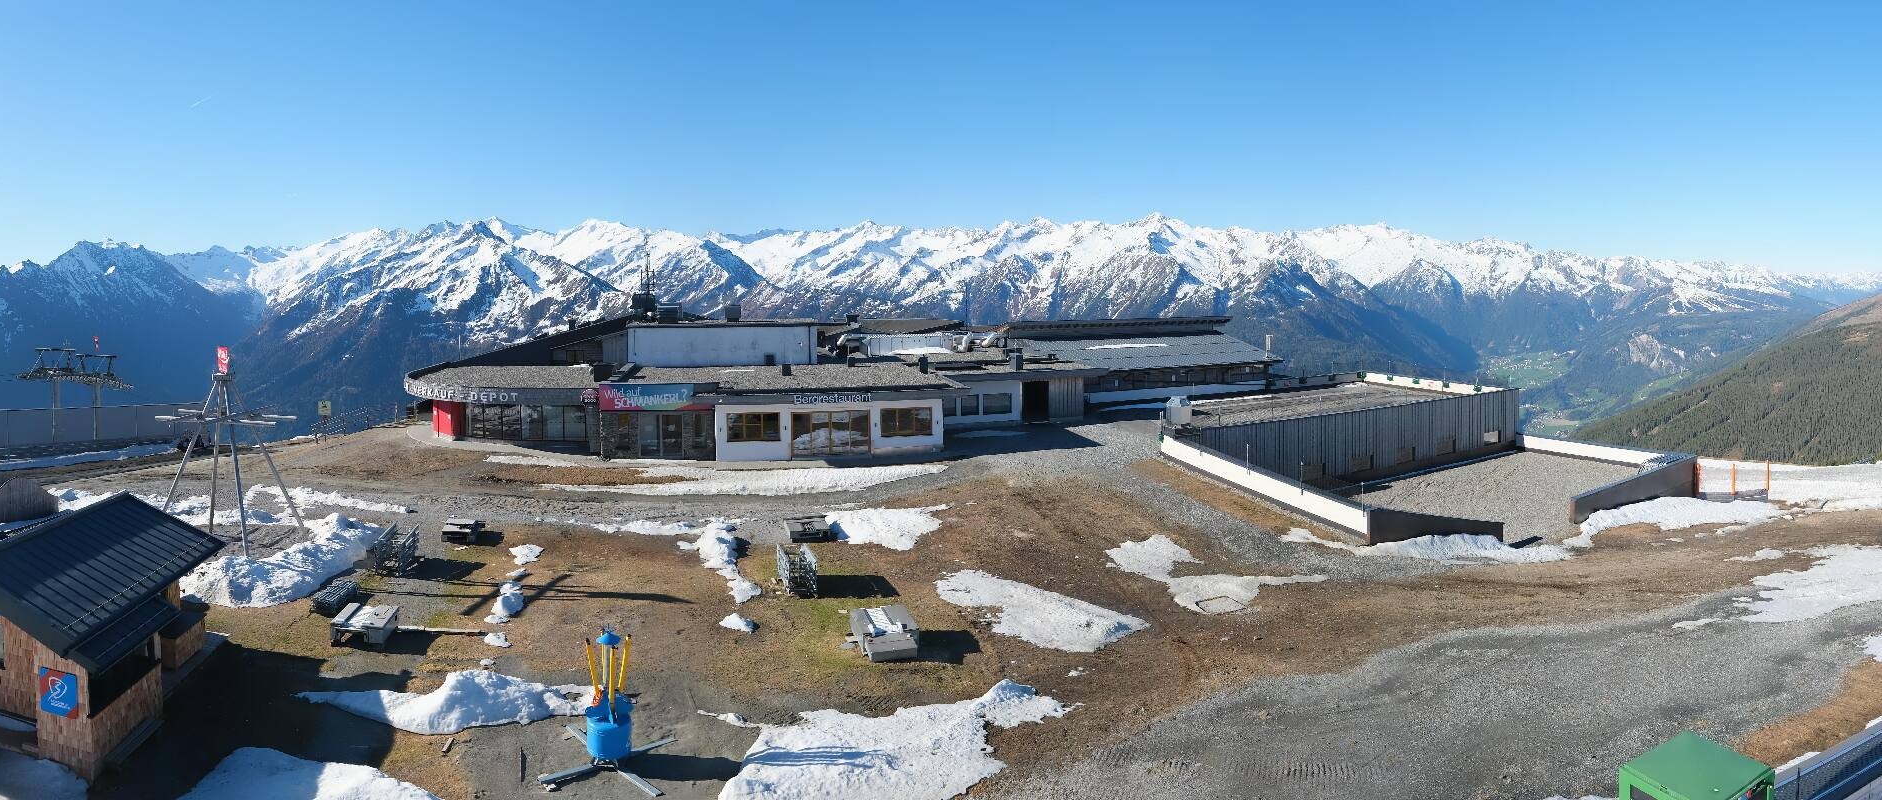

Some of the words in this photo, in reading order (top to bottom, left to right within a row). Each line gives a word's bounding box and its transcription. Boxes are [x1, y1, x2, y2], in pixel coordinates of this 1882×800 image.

[413, 384, 454, 400] VERKAUF
[470, 391, 519, 402] DEPOT
[604, 388, 624, 400] Wild
[626, 387, 642, 398] auf
[614, 388, 688, 409] SCHMANKERL?
[794, 392, 872, 405] Bergrestaurant
